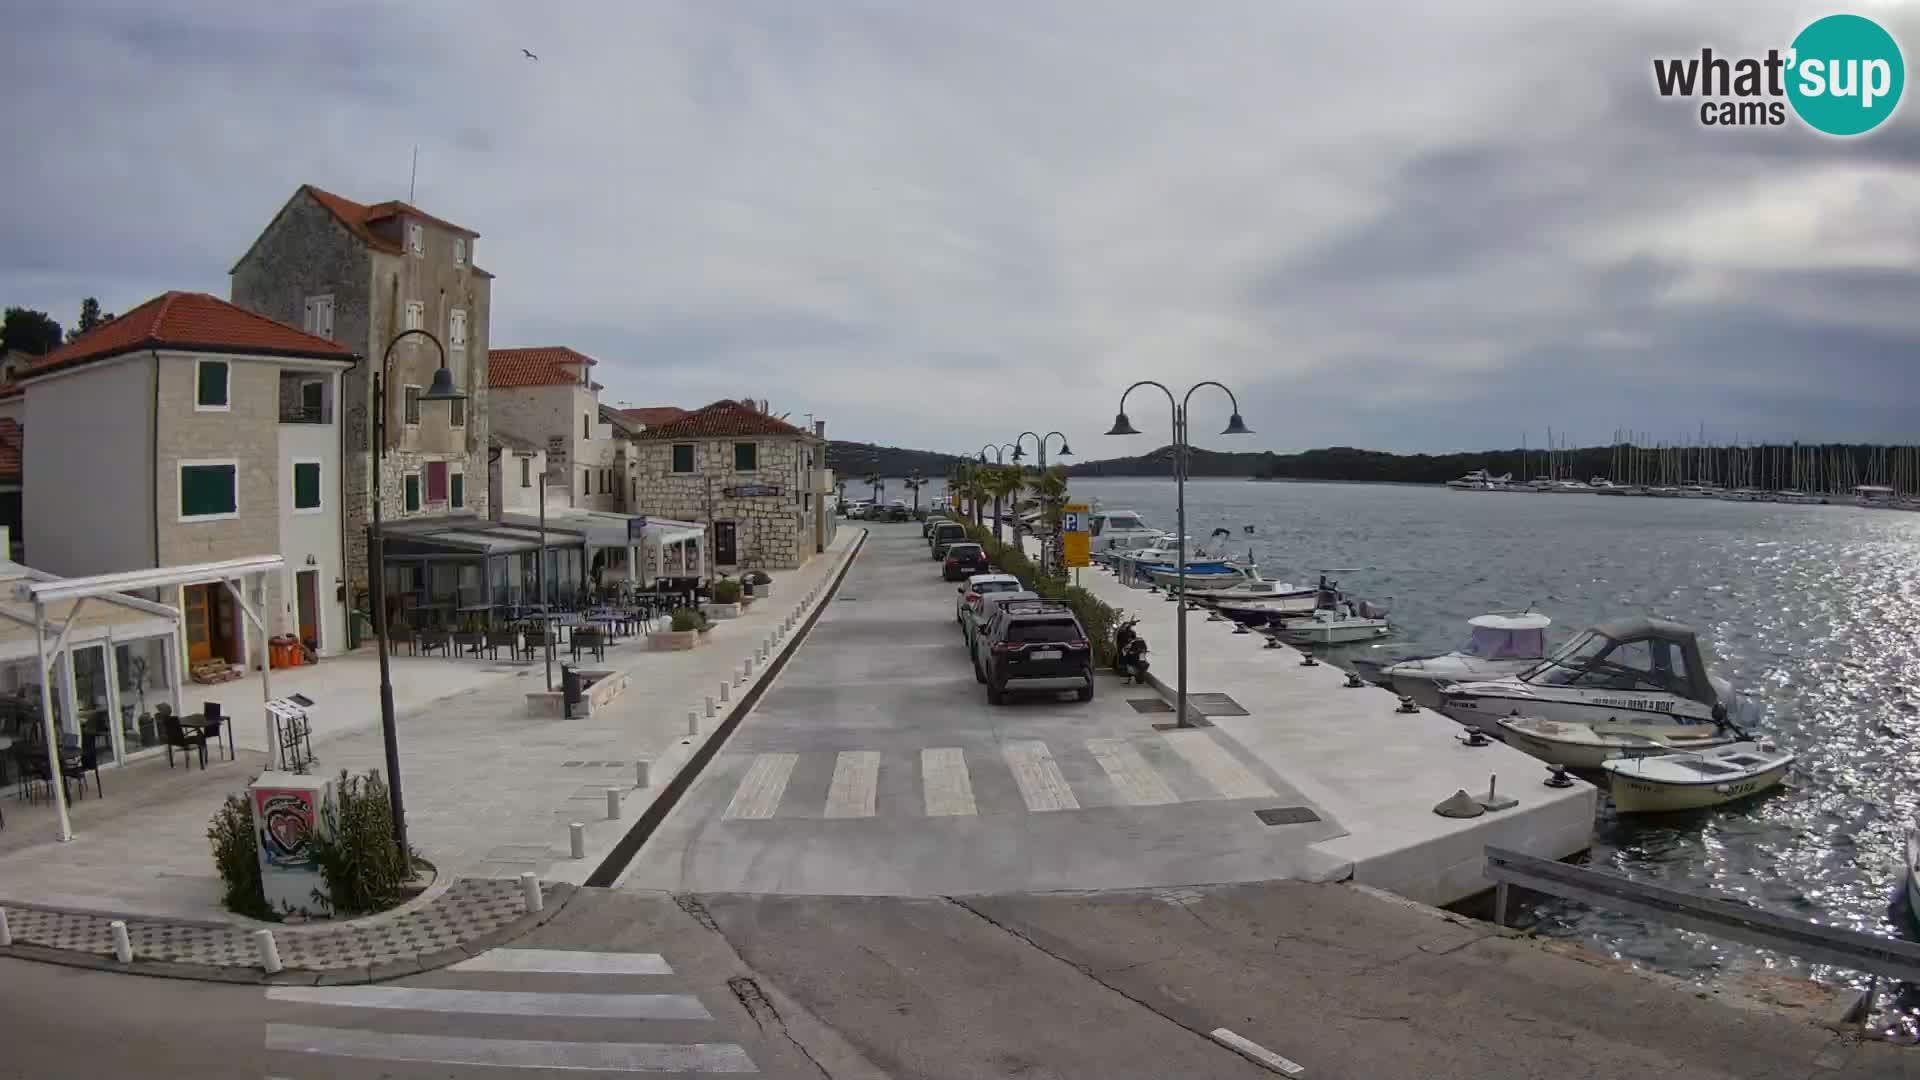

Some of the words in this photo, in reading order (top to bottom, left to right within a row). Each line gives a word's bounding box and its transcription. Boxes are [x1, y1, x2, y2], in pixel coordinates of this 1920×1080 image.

[1066, 513, 1077, 529] P
[1628, 699, 1648, 710] RENT
[1655, 700, 1675, 712] BOAT
